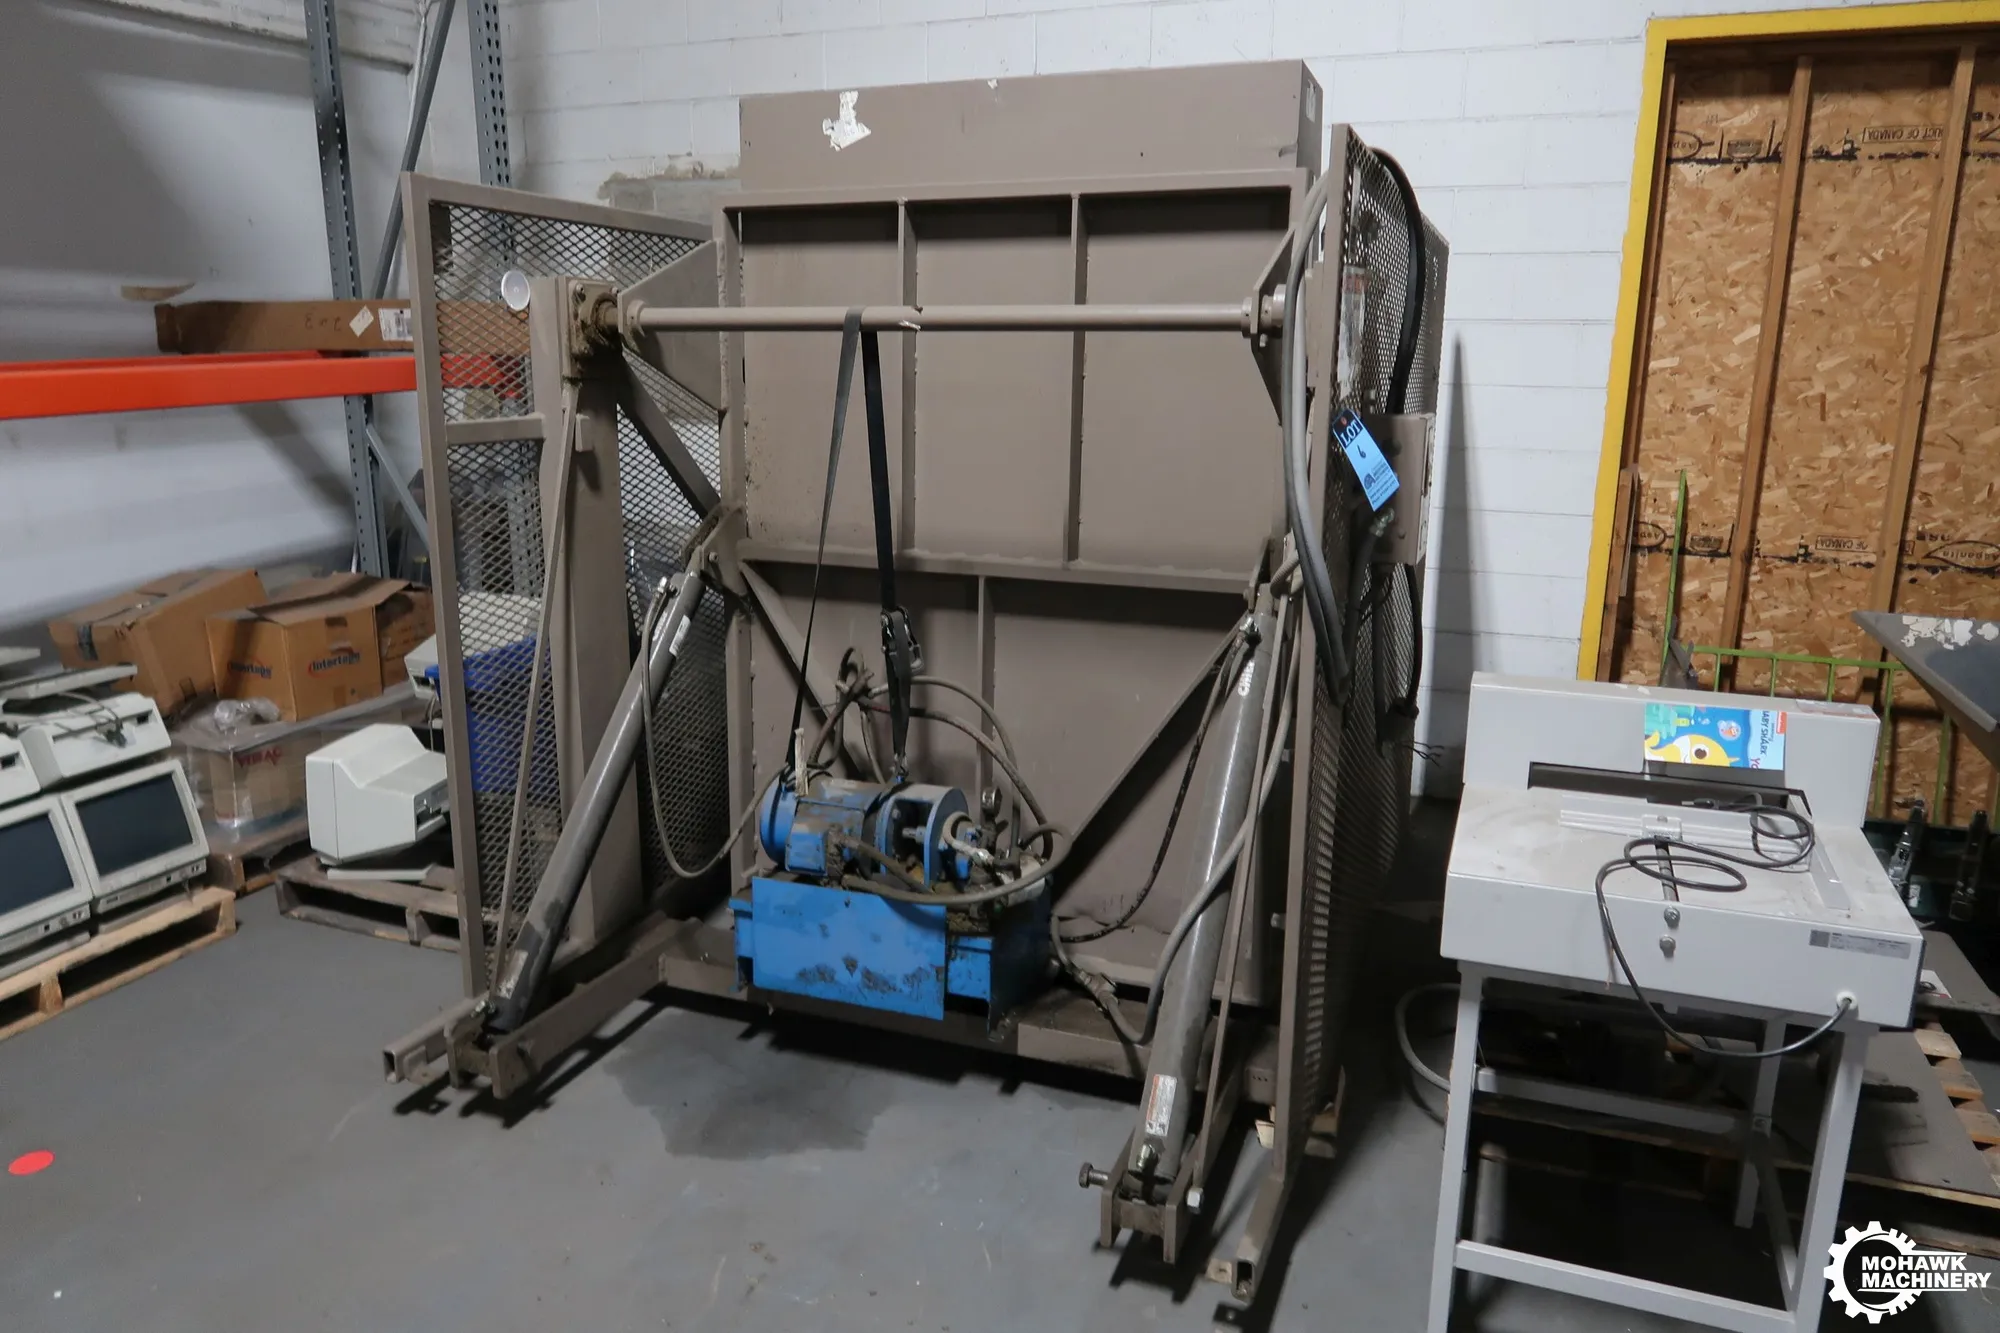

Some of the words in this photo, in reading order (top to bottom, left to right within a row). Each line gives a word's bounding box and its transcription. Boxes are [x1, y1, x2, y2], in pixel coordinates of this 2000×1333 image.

[1867, 128, 1904, 141] CANADA
[1907, 128, 1919, 140] OF
[1340, 419, 1361, 447] LOT
[1356, 444, 1366, 459] 6
[1819, 538, 1854, 549] CANADA
[1760, 728, 1769, 755] SHARK
